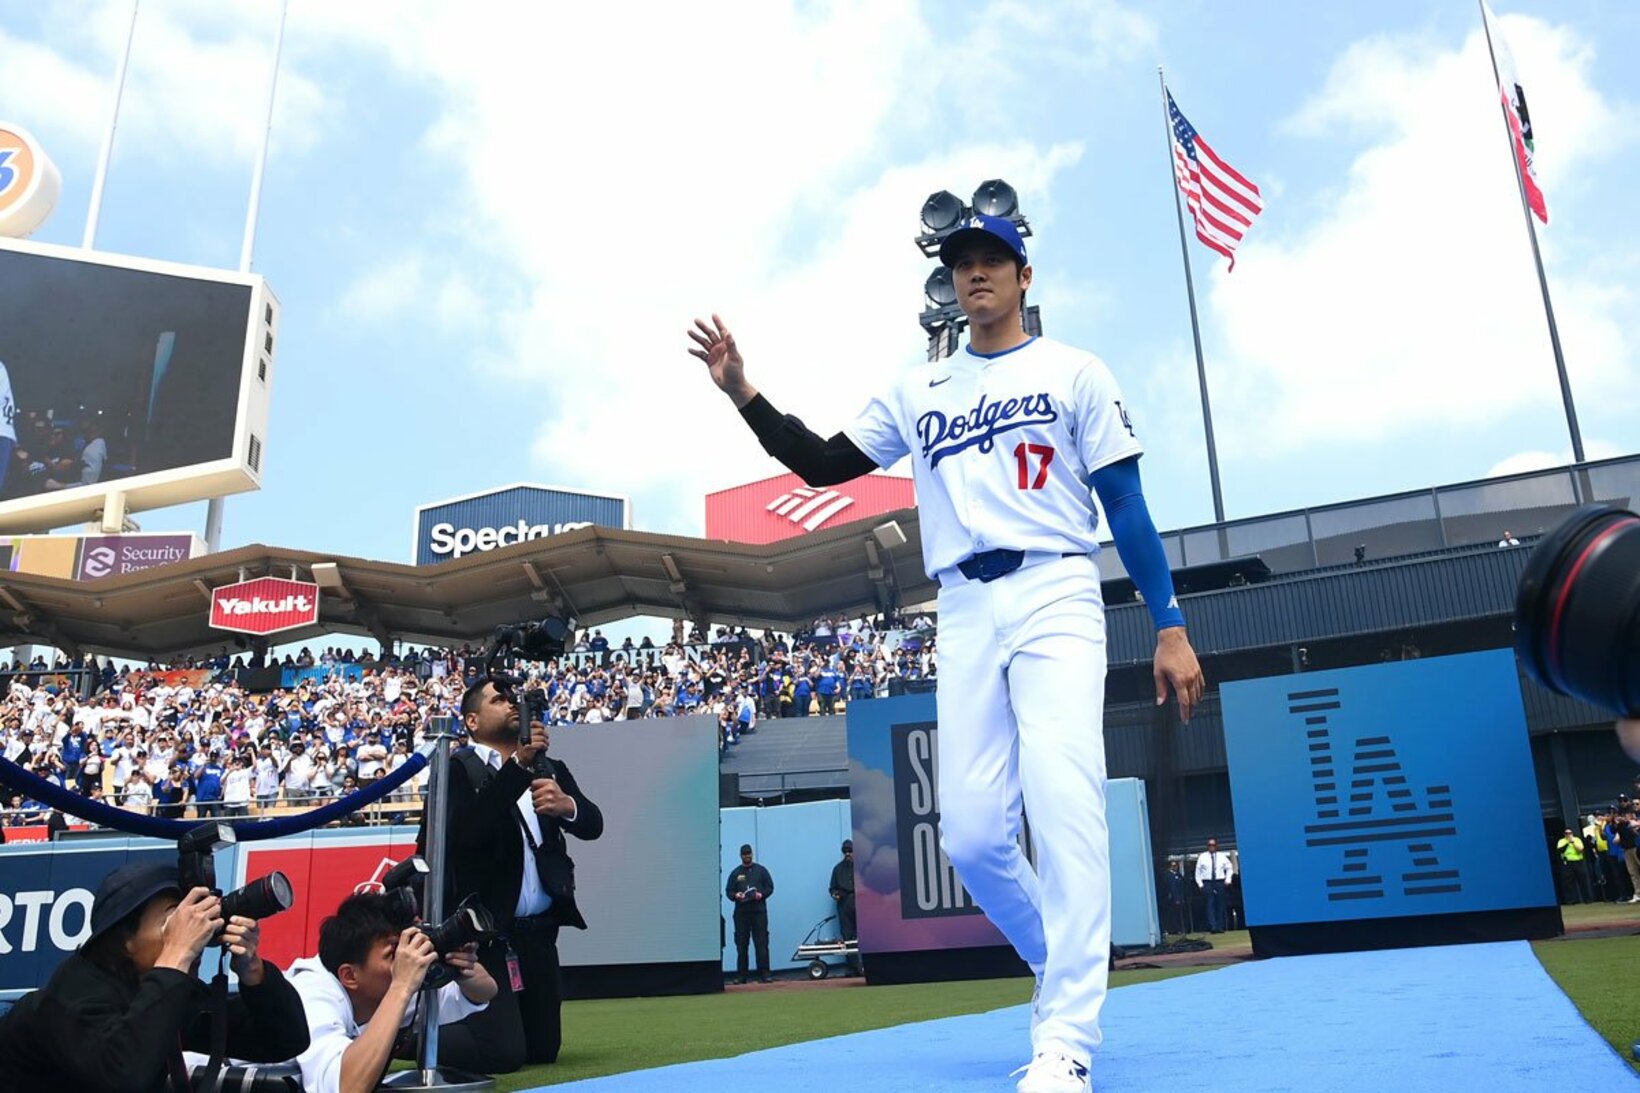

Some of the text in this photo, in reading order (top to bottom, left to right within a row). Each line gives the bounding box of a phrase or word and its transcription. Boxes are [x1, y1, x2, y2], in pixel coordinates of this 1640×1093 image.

[917, 392, 1058, 470] Dodgers
[1013, 442, 1055, 490] 17
[121, 545, 185, 563] Security
[430, 519, 595, 559] Spectr
[217, 595, 312, 616] Yakult
[1287, 688, 1462, 901] LA
